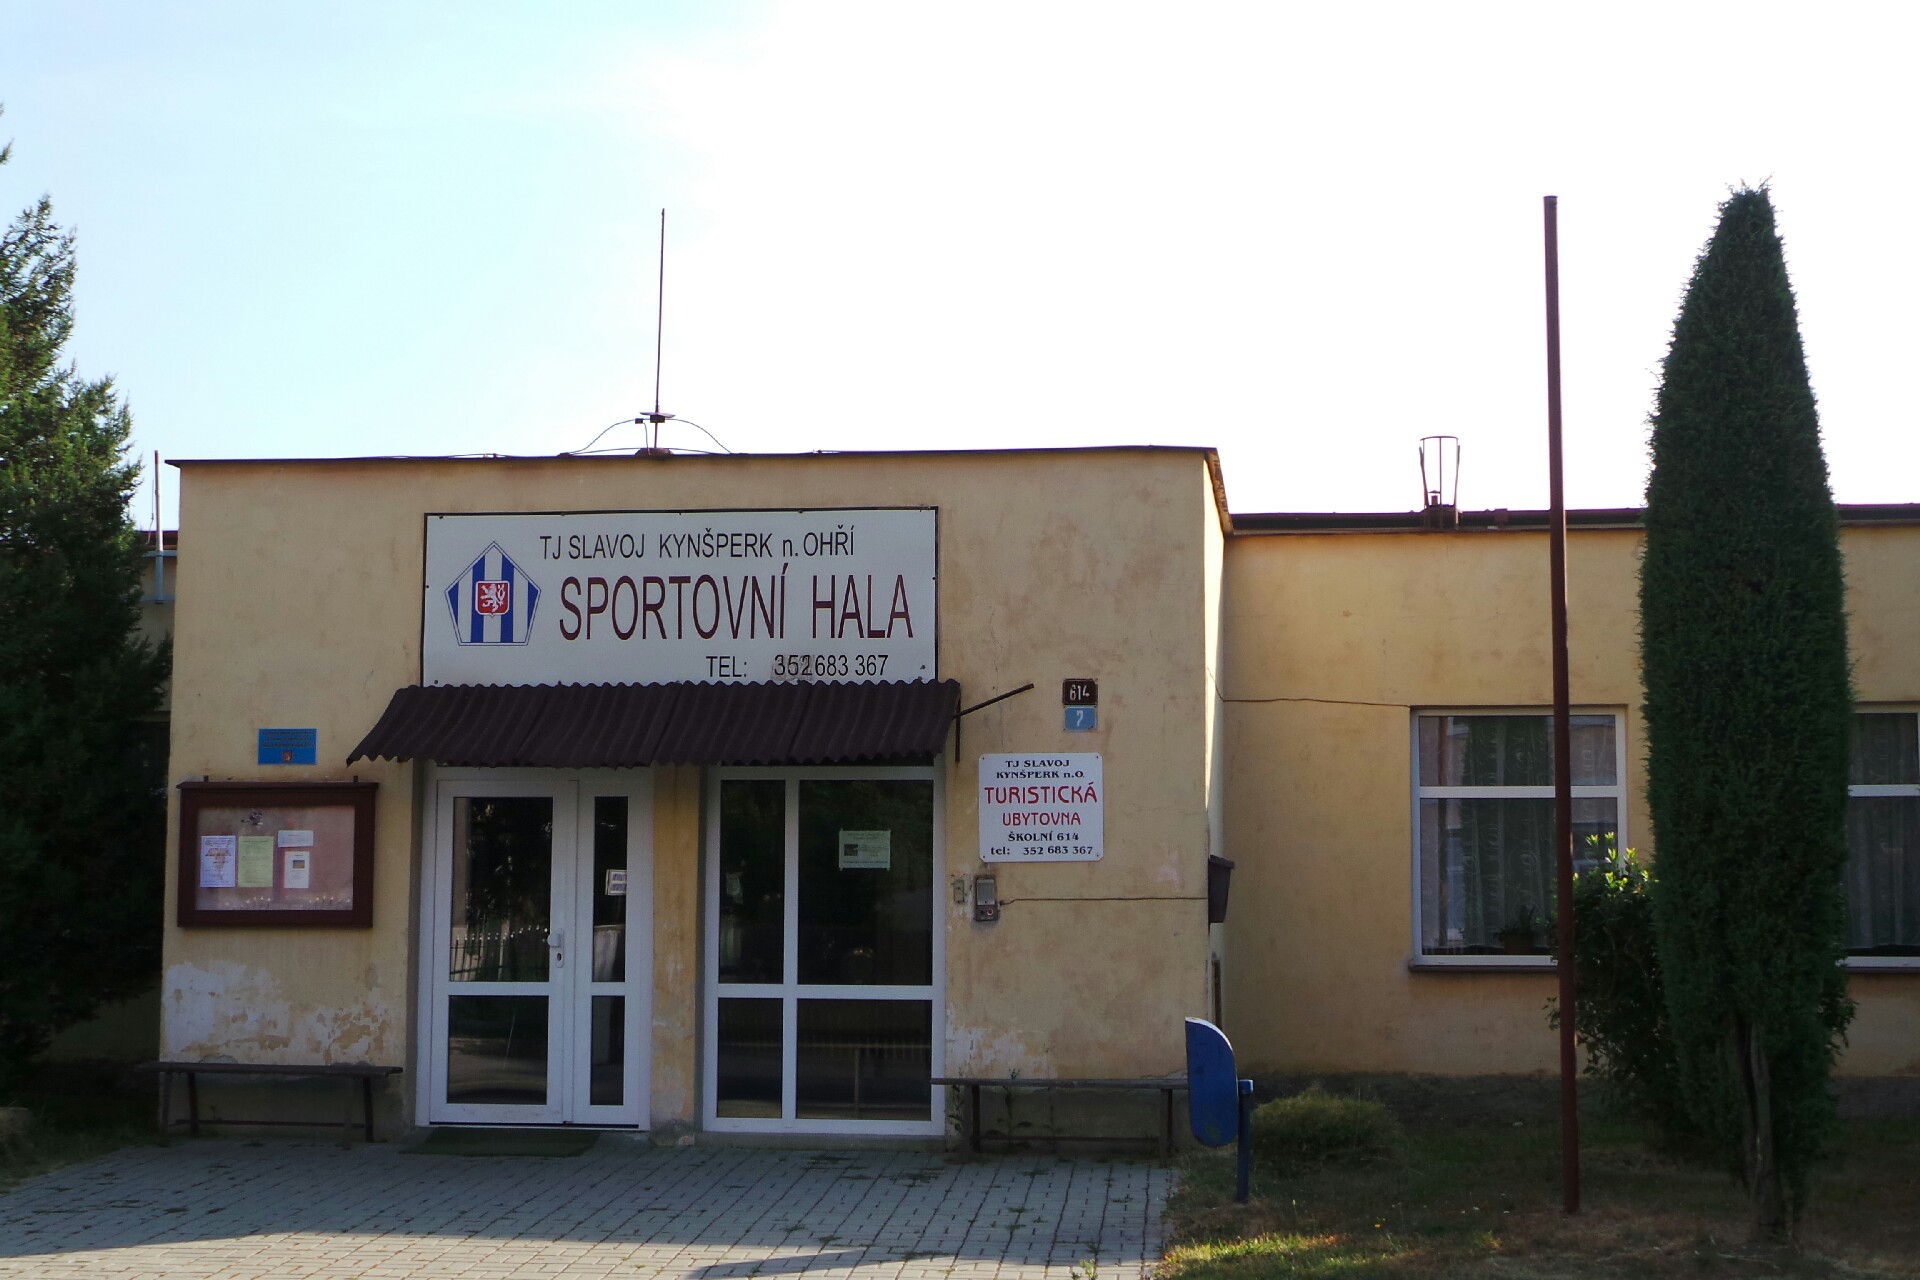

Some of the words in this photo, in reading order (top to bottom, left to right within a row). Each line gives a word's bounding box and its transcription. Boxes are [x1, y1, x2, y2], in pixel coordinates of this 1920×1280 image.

[539, 535, 561, 559] TJ
[568, 533, 645, 559] SLAVOJ
[659, 527, 773, 558] KYNŠPERK
[558, 562, 790, 641] SPORTOVNÍ
[811, 574, 914, 640] HALA
[705, 655, 748, 678] TEL:
[1070, 684, 1090, 701] 614
[1076, 710, 1084, 727] 7
[1005, 760, 1020, 768] TJ
[1023, 759, 1070, 768] SLAVOJ
[996, 770, 1060, 779] KYNŠPERK
[984, 781, 1098, 804] TURISTICKÁ
[1002, 812, 1081, 826] UBYTOVNA
[1008, 831, 1054, 842] ŠKOLNÍ
[1056, 832, 1079, 841] 614
[990, 847, 1011, 856] tel:
[1022, 847, 1044, 856] 352
[1047, 845, 1069, 855] 683
[1072, 846, 1093, 855] 367
